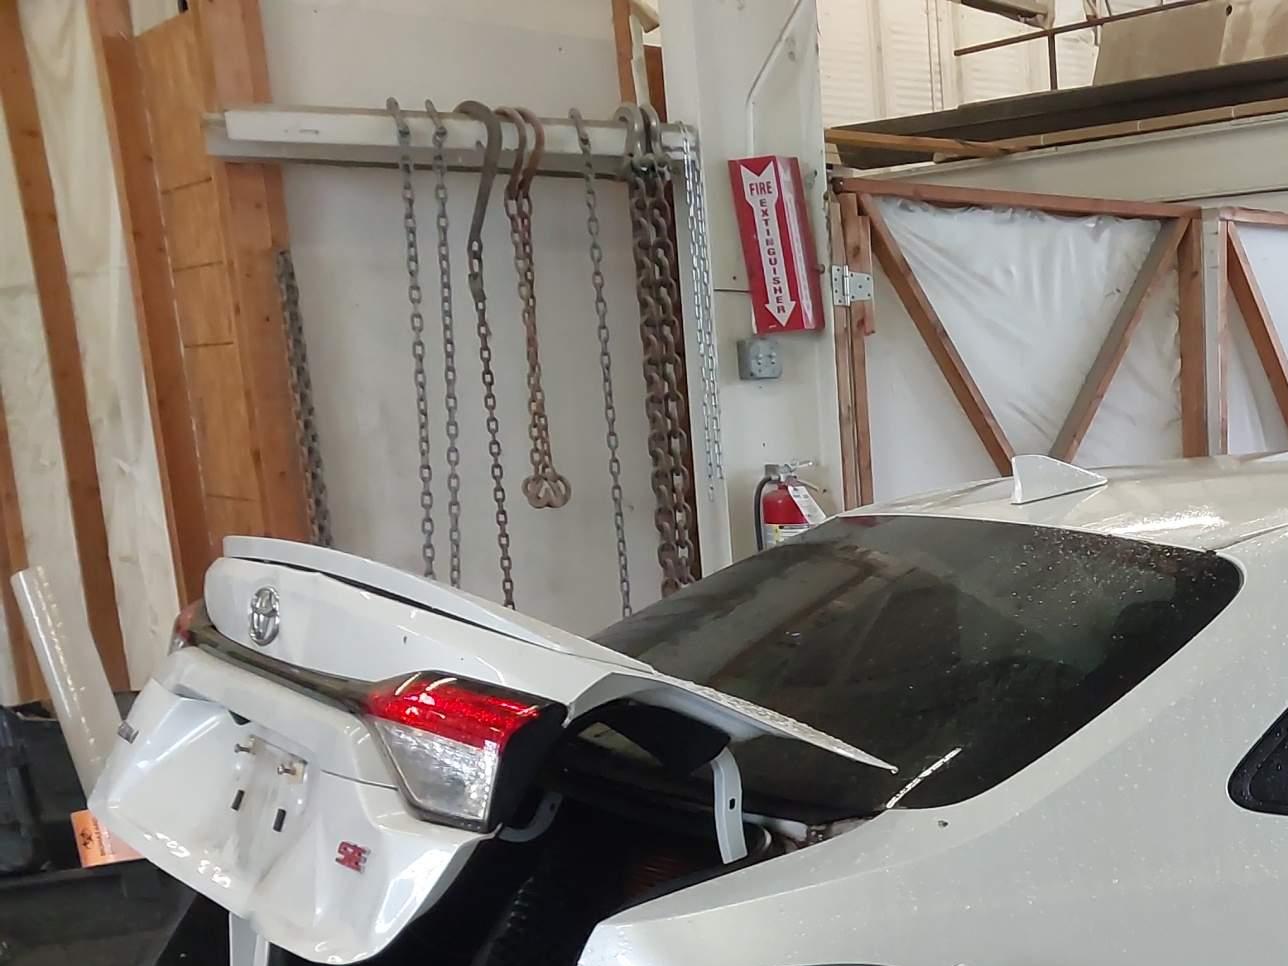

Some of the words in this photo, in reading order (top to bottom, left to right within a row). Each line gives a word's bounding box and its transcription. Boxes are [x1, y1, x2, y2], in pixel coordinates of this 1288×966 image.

[748, 181, 773, 196] FIRE
[759, 198, 786, 314] EXTINGUISHER
[335, 841, 369, 873] SE
